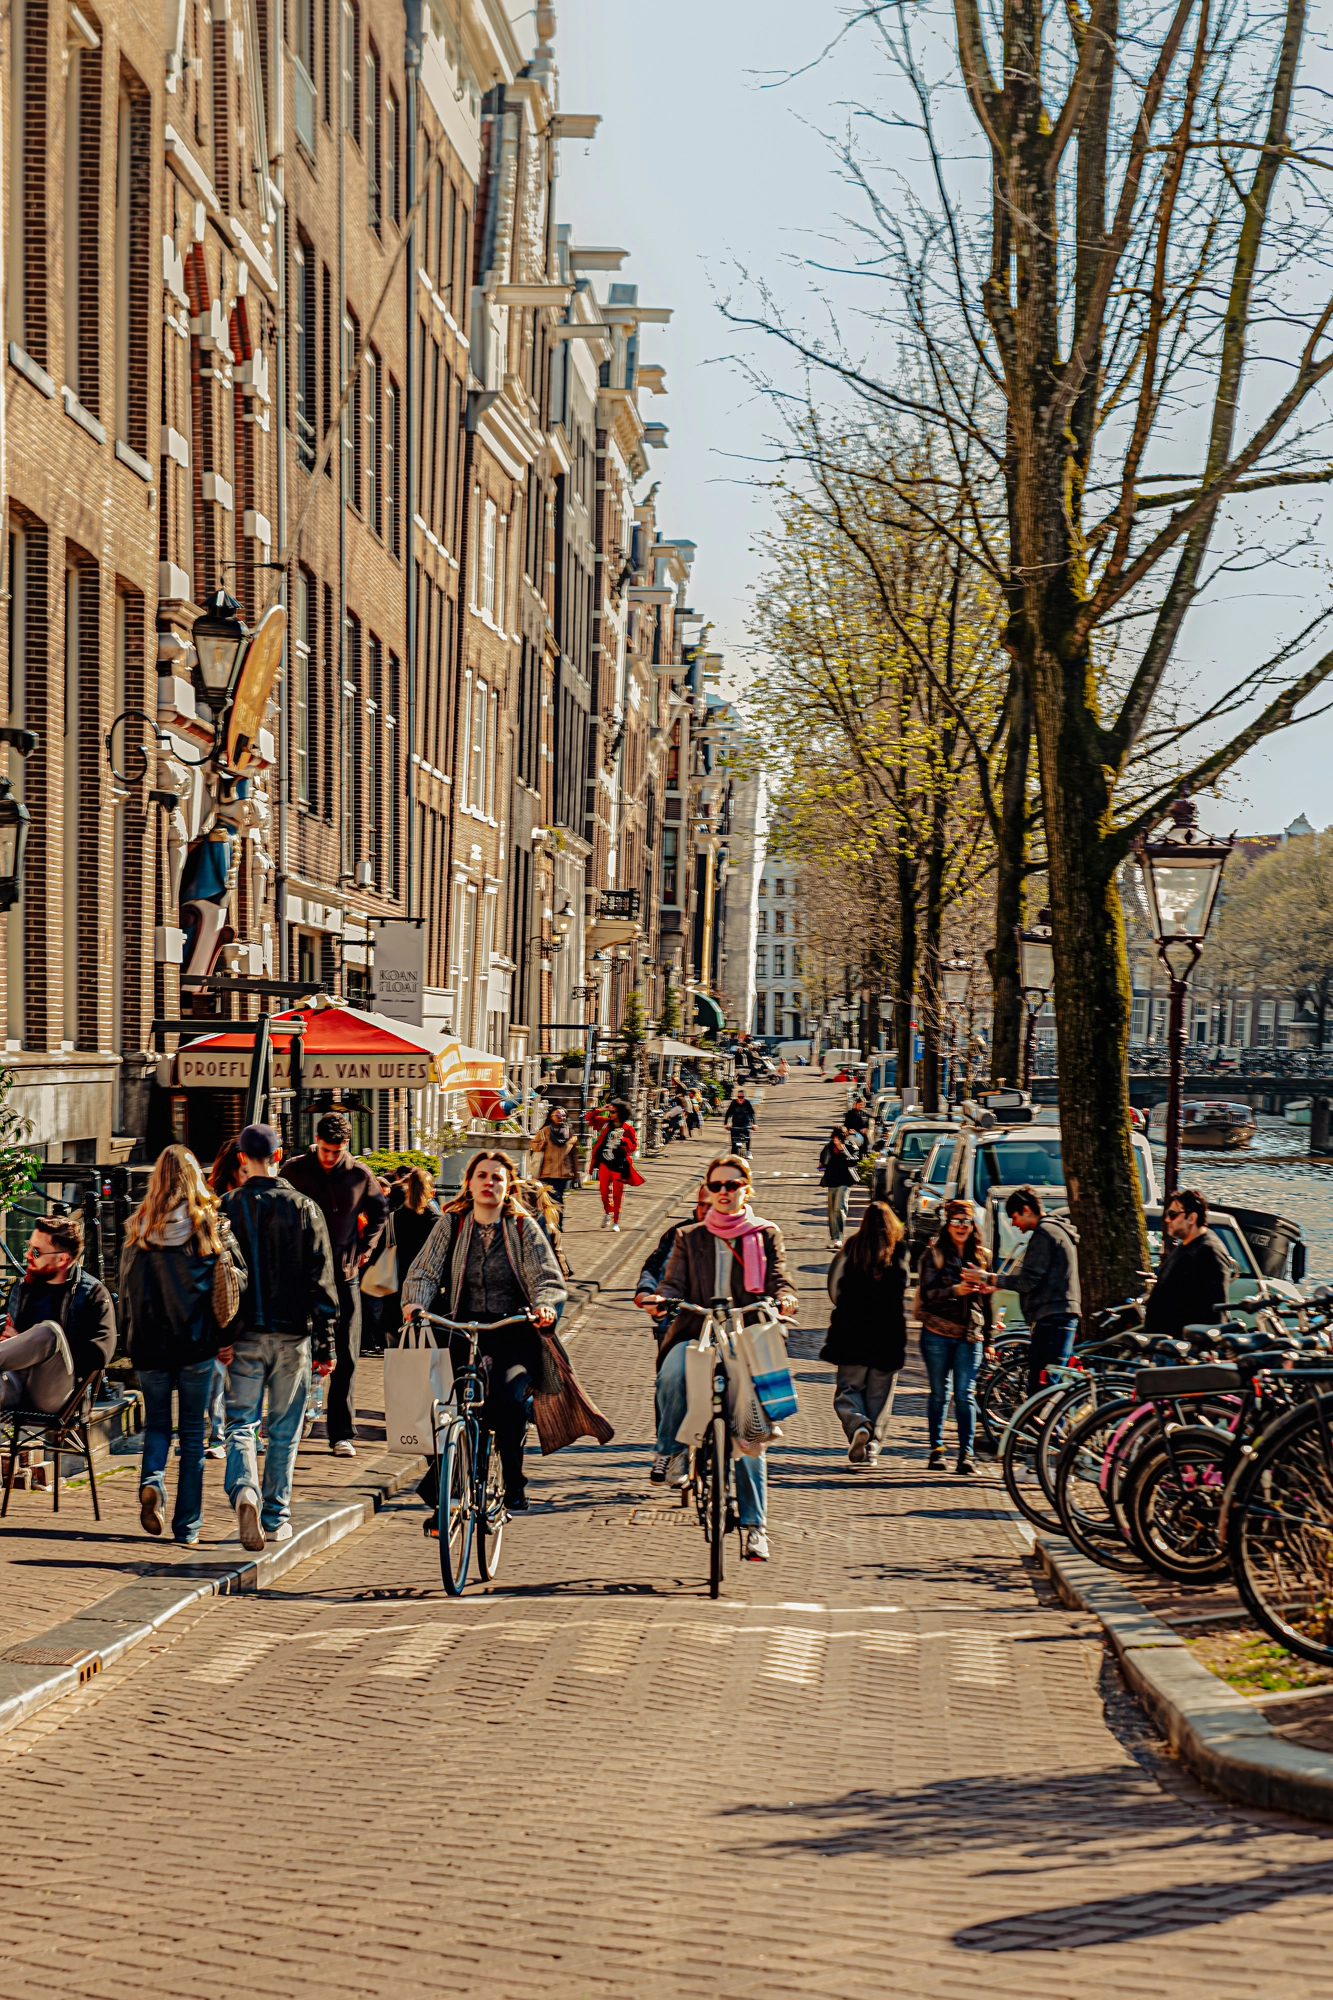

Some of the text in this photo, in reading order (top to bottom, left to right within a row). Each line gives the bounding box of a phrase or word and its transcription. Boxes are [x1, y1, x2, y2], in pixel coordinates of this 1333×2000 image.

[379, 970, 418, 981] KOAN
[183, 1062, 427, 1079] PROEFLAA A. VAN WEES
[400, 1435, 418, 1445] COS
